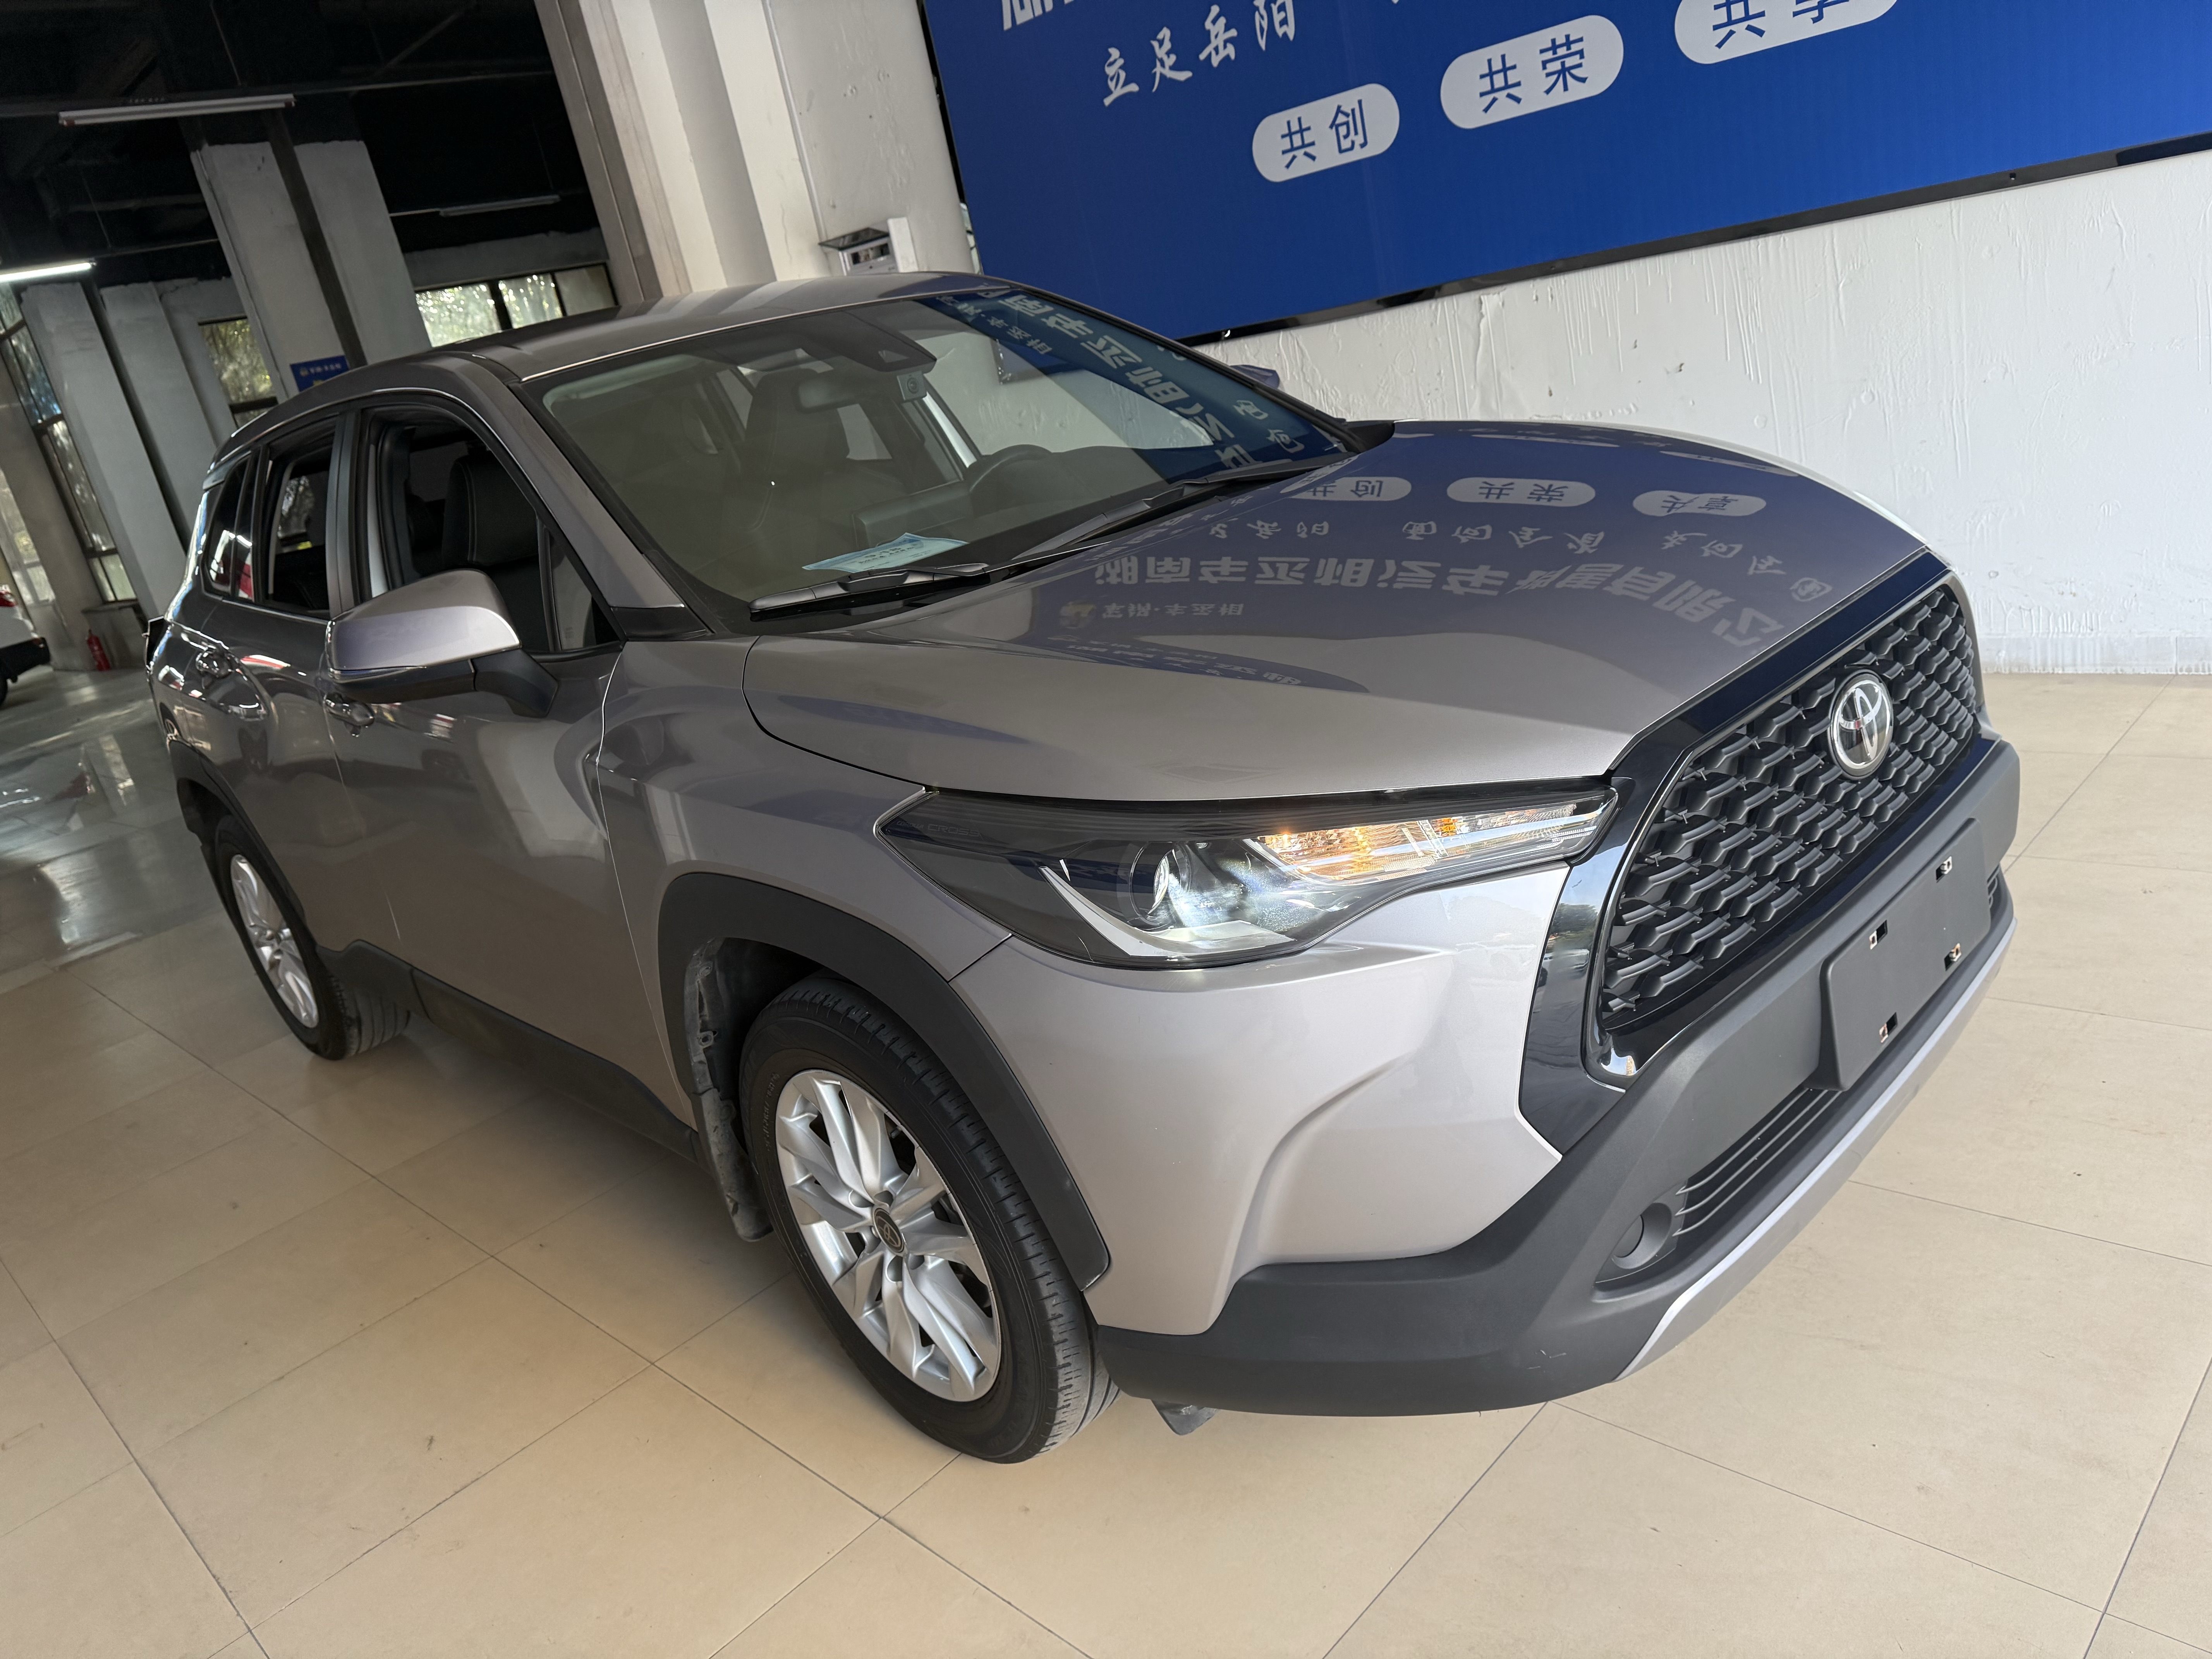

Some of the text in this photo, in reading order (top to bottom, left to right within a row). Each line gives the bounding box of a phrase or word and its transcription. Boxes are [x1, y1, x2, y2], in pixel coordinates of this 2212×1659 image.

[1479, 33, 1589, 114] 共荣
[1279, 98, 1369, 169] 共创
[927, 823, 981, 837] CROSS
